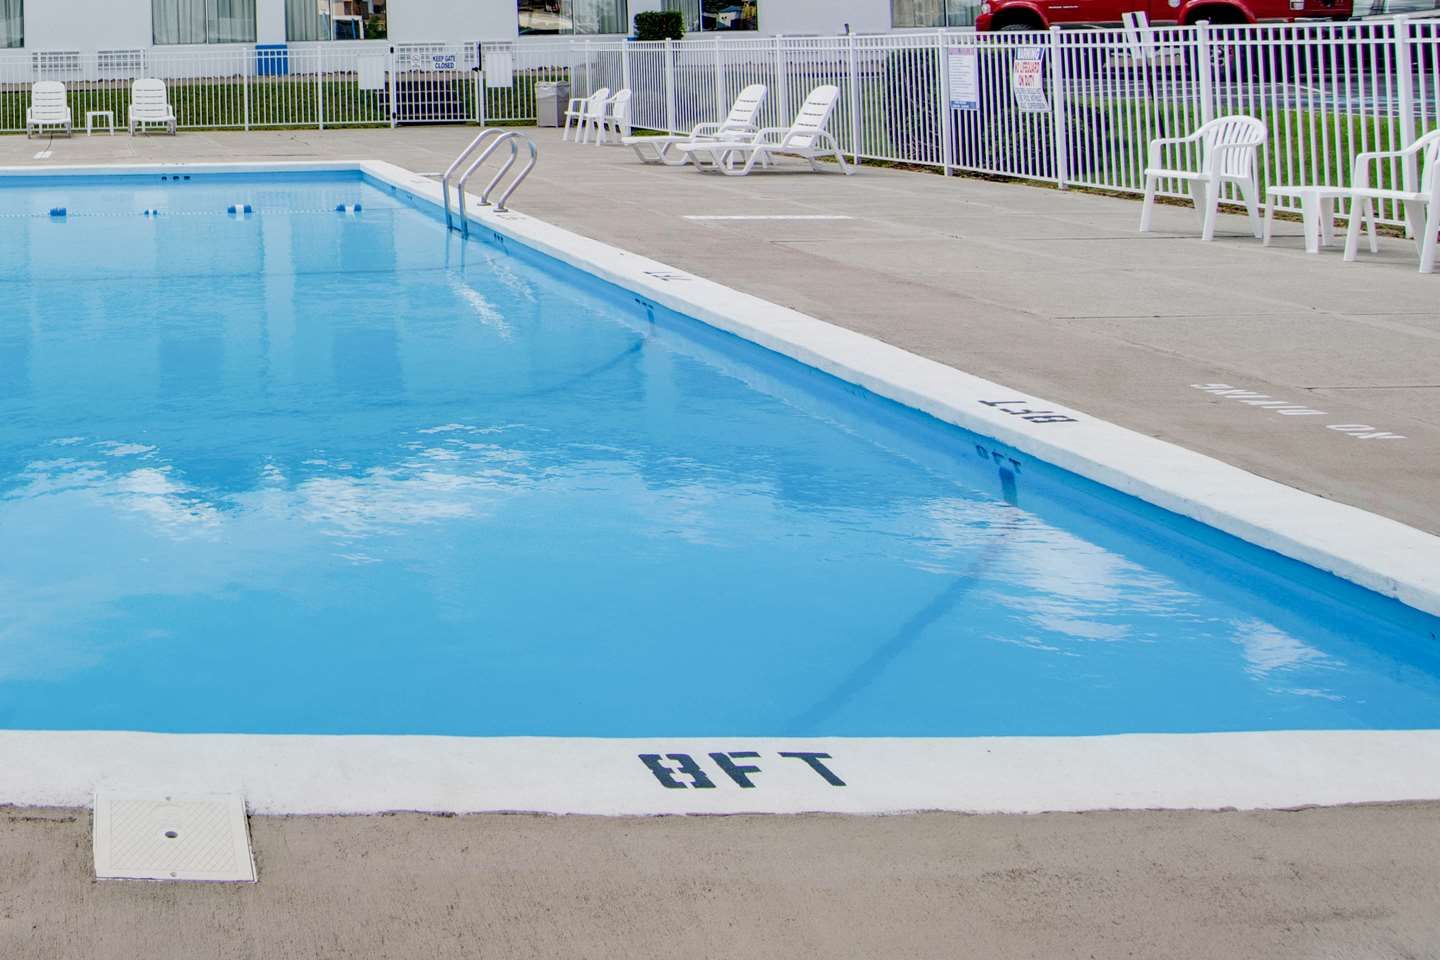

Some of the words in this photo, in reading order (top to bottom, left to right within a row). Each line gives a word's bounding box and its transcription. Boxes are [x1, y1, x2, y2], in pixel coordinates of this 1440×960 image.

[1191, 383, 1328, 416] DIVING
[1325, 424, 1408, 439] NO
[638, 751, 847, 789] 8FT
